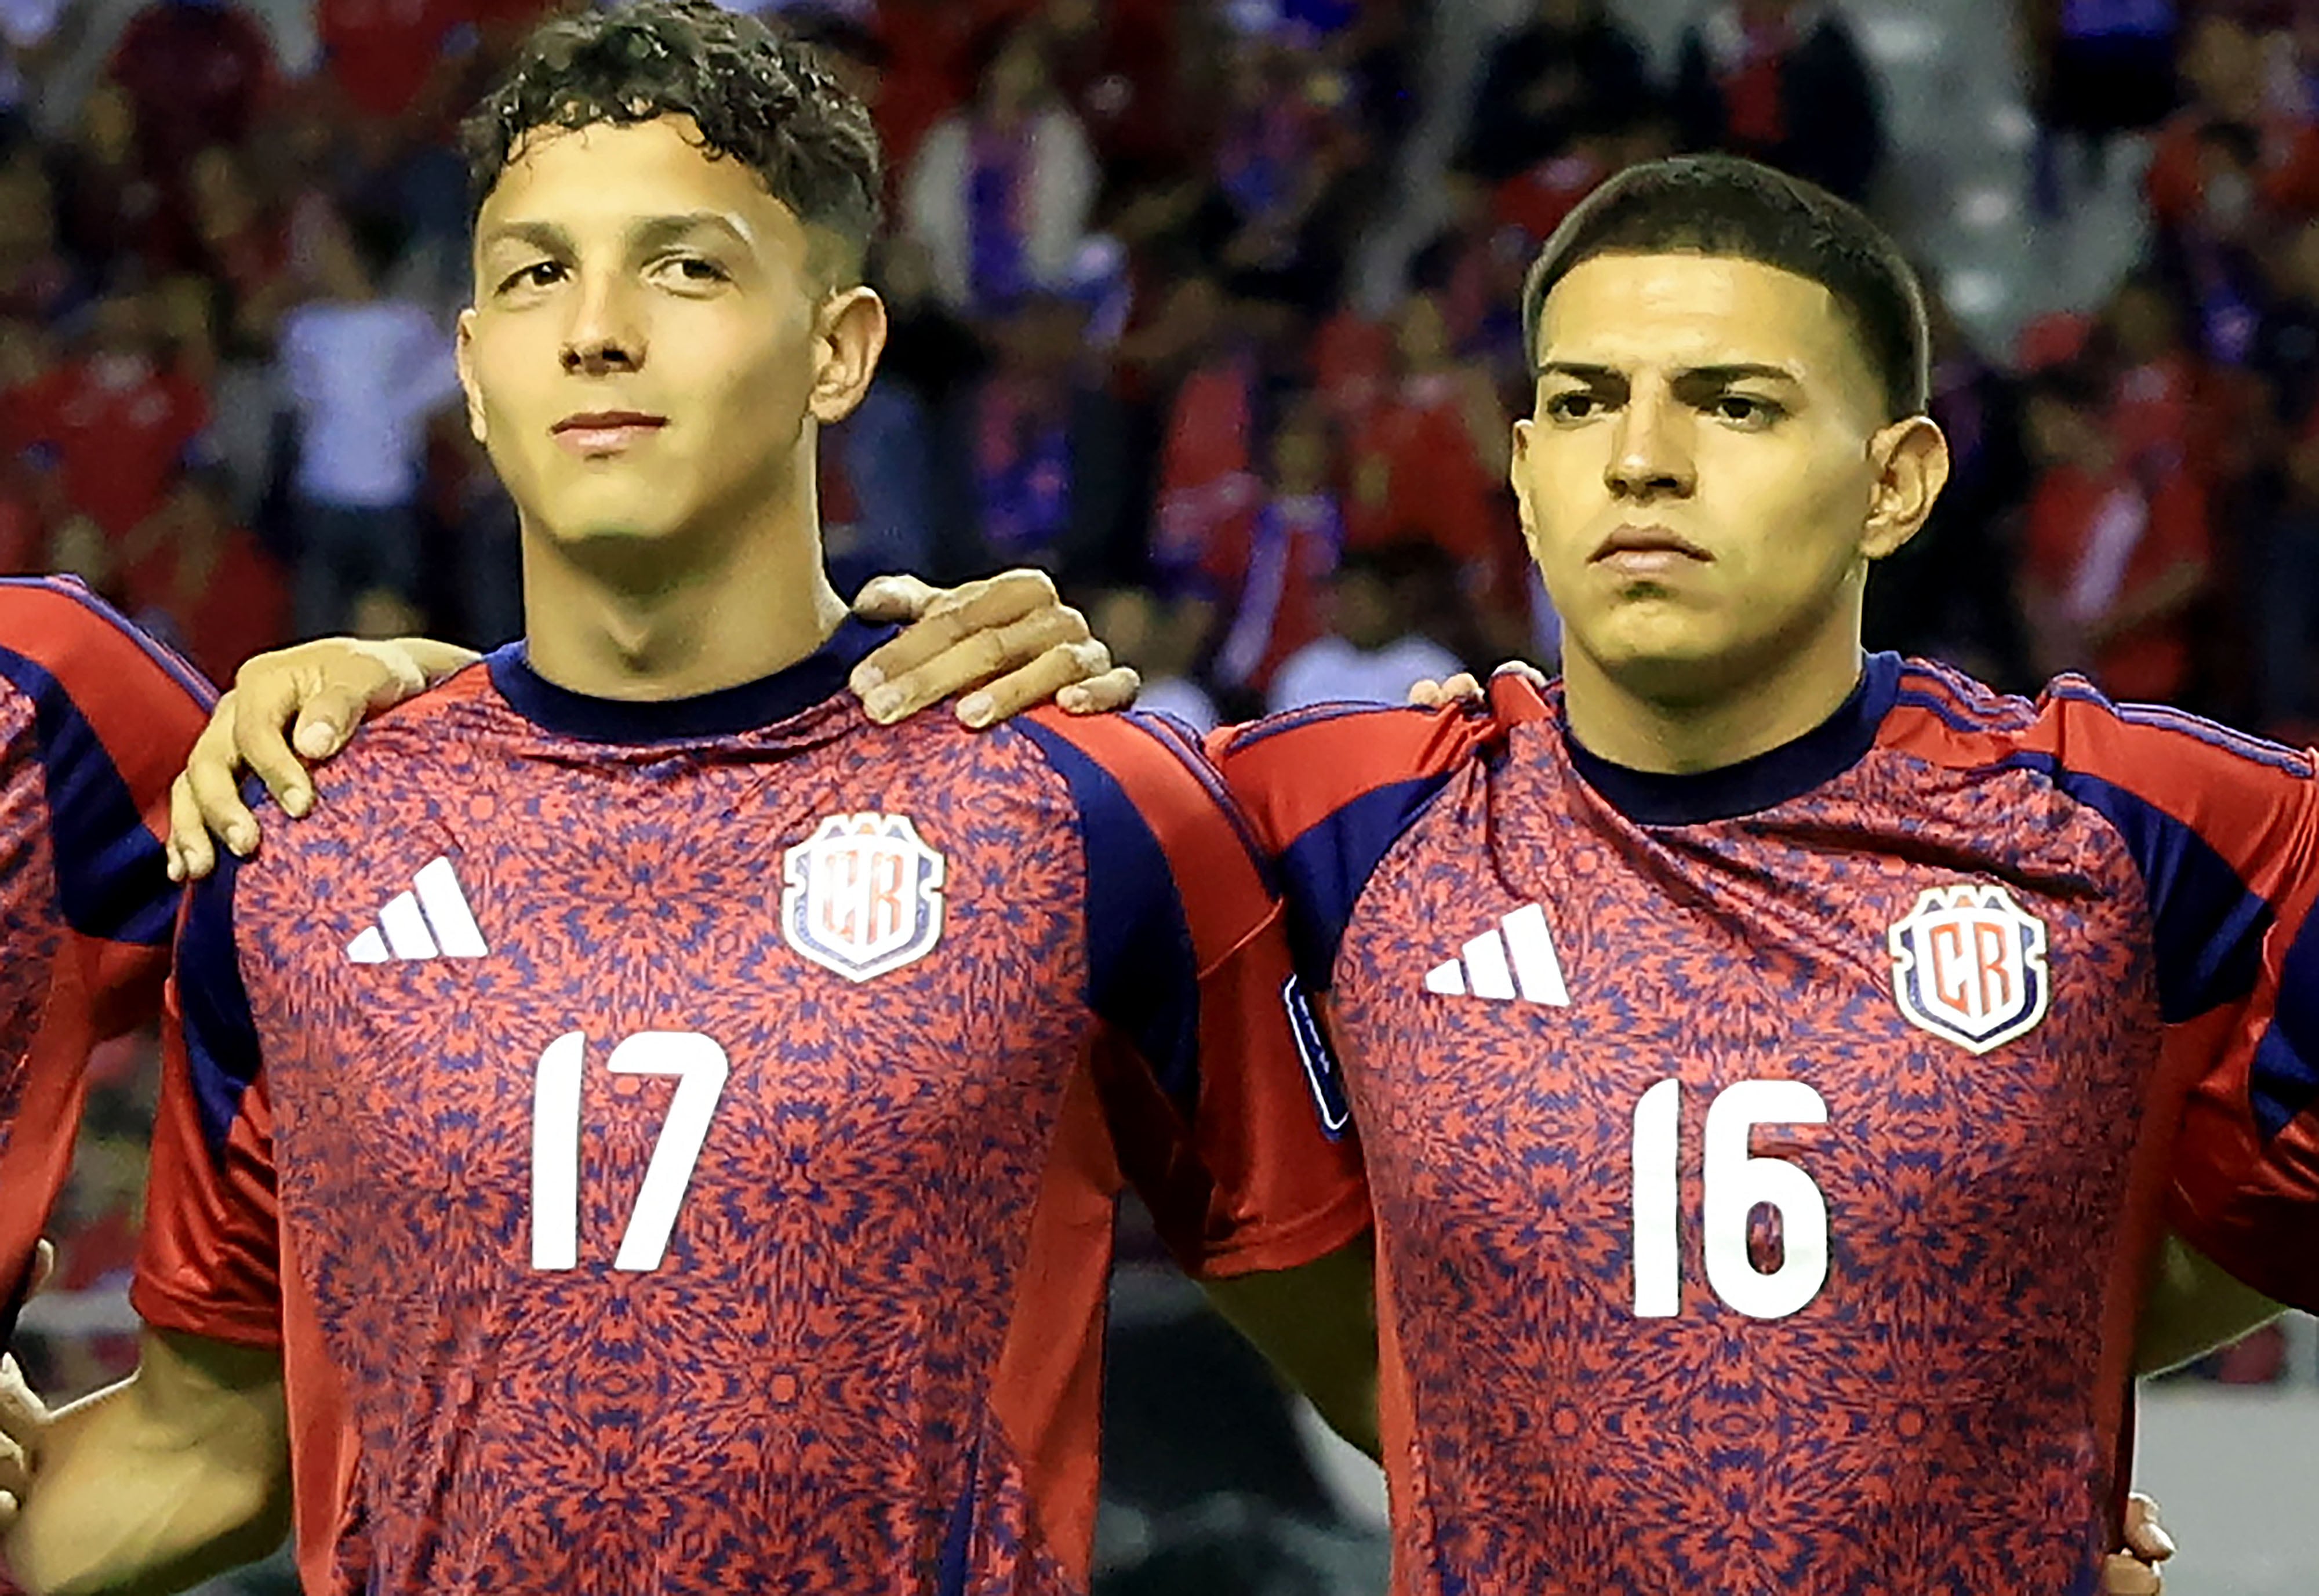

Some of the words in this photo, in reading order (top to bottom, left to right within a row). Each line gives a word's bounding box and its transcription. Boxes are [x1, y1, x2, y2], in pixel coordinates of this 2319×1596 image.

[1929, 921, 2011, 1017] CR
[531, 1030, 729, 1271] 17
[1632, 1078, 1829, 1319] 16
